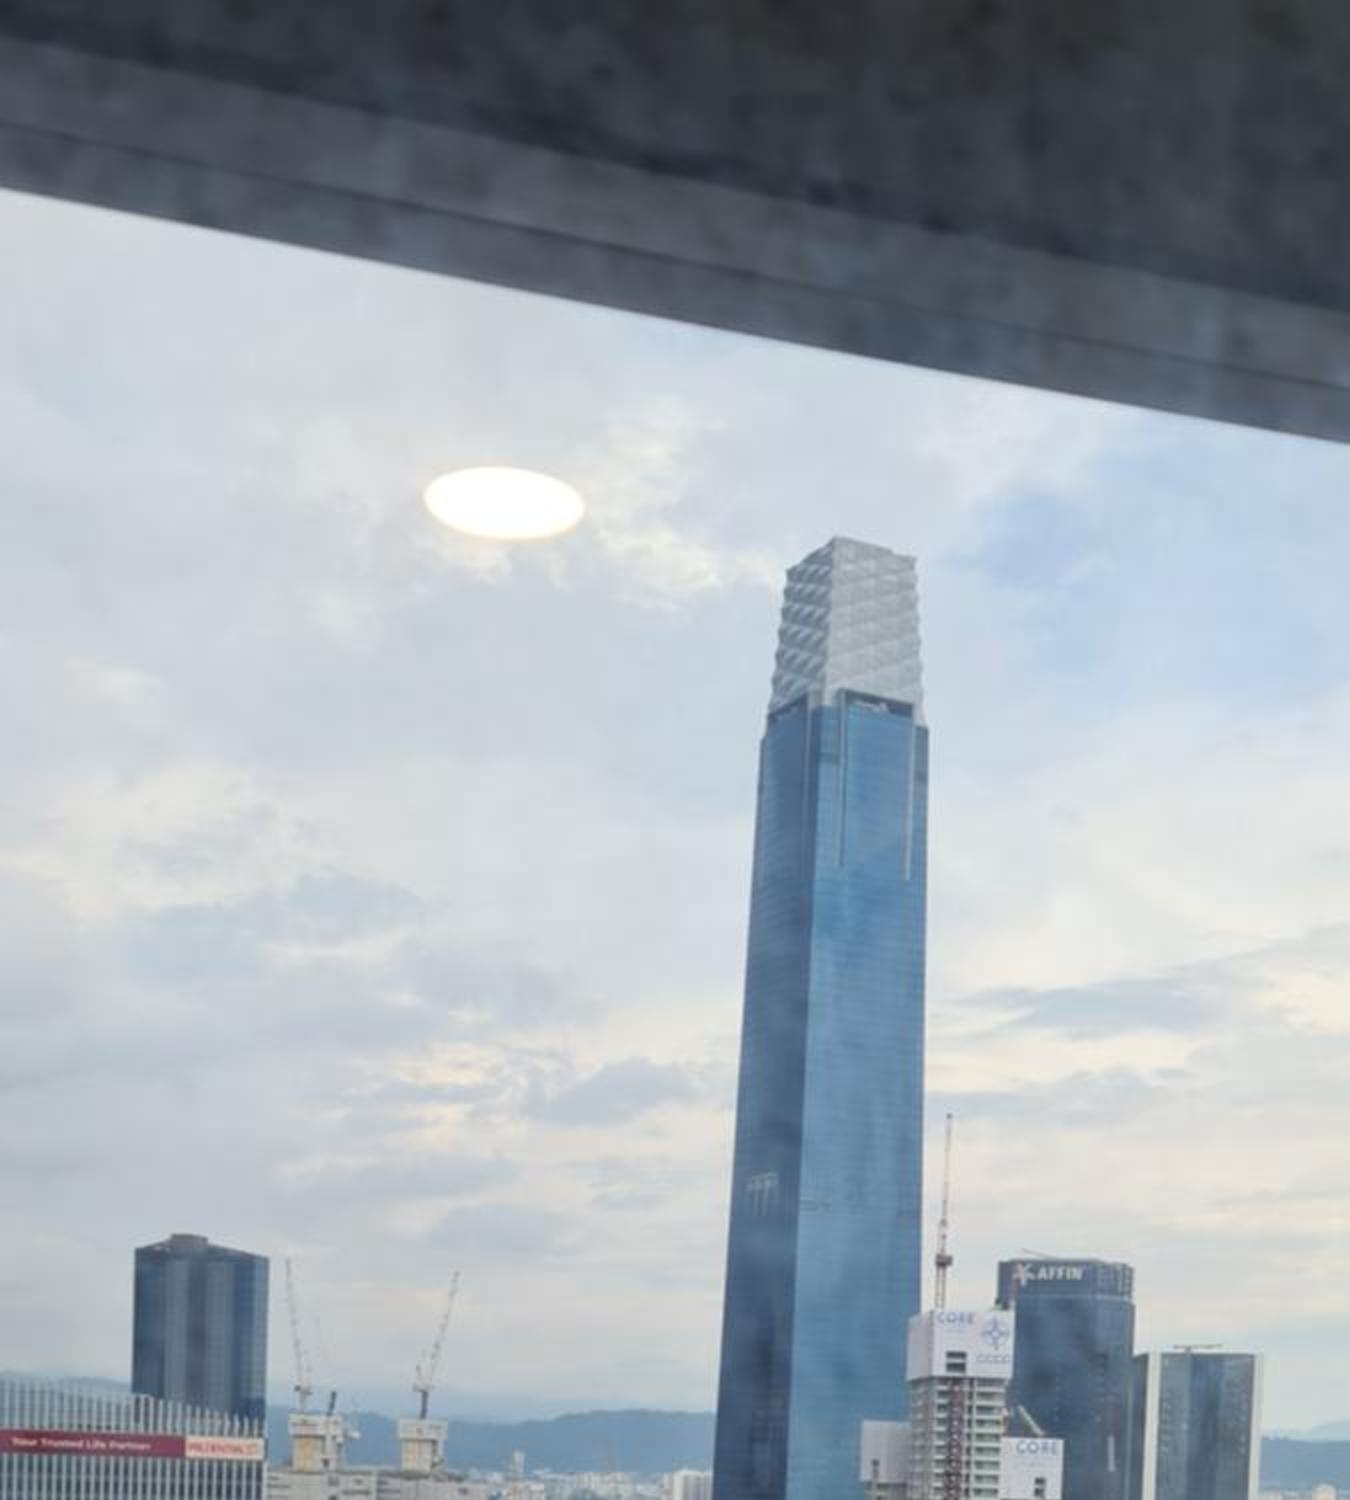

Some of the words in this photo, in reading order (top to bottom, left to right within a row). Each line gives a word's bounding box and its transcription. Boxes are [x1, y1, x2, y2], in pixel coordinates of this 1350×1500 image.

[1038, 1264, 1083, 1281] AFFIN
[936, 1311, 973, 1325] CORE
[12, 1437, 37, 1447] Your
[41, 1438, 83, 1449] Trusted
[86, 1440, 106, 1450] Life
[109, 1441, 151, 1451] Partner
[1016, 1440, 1057, 1455] CORE
